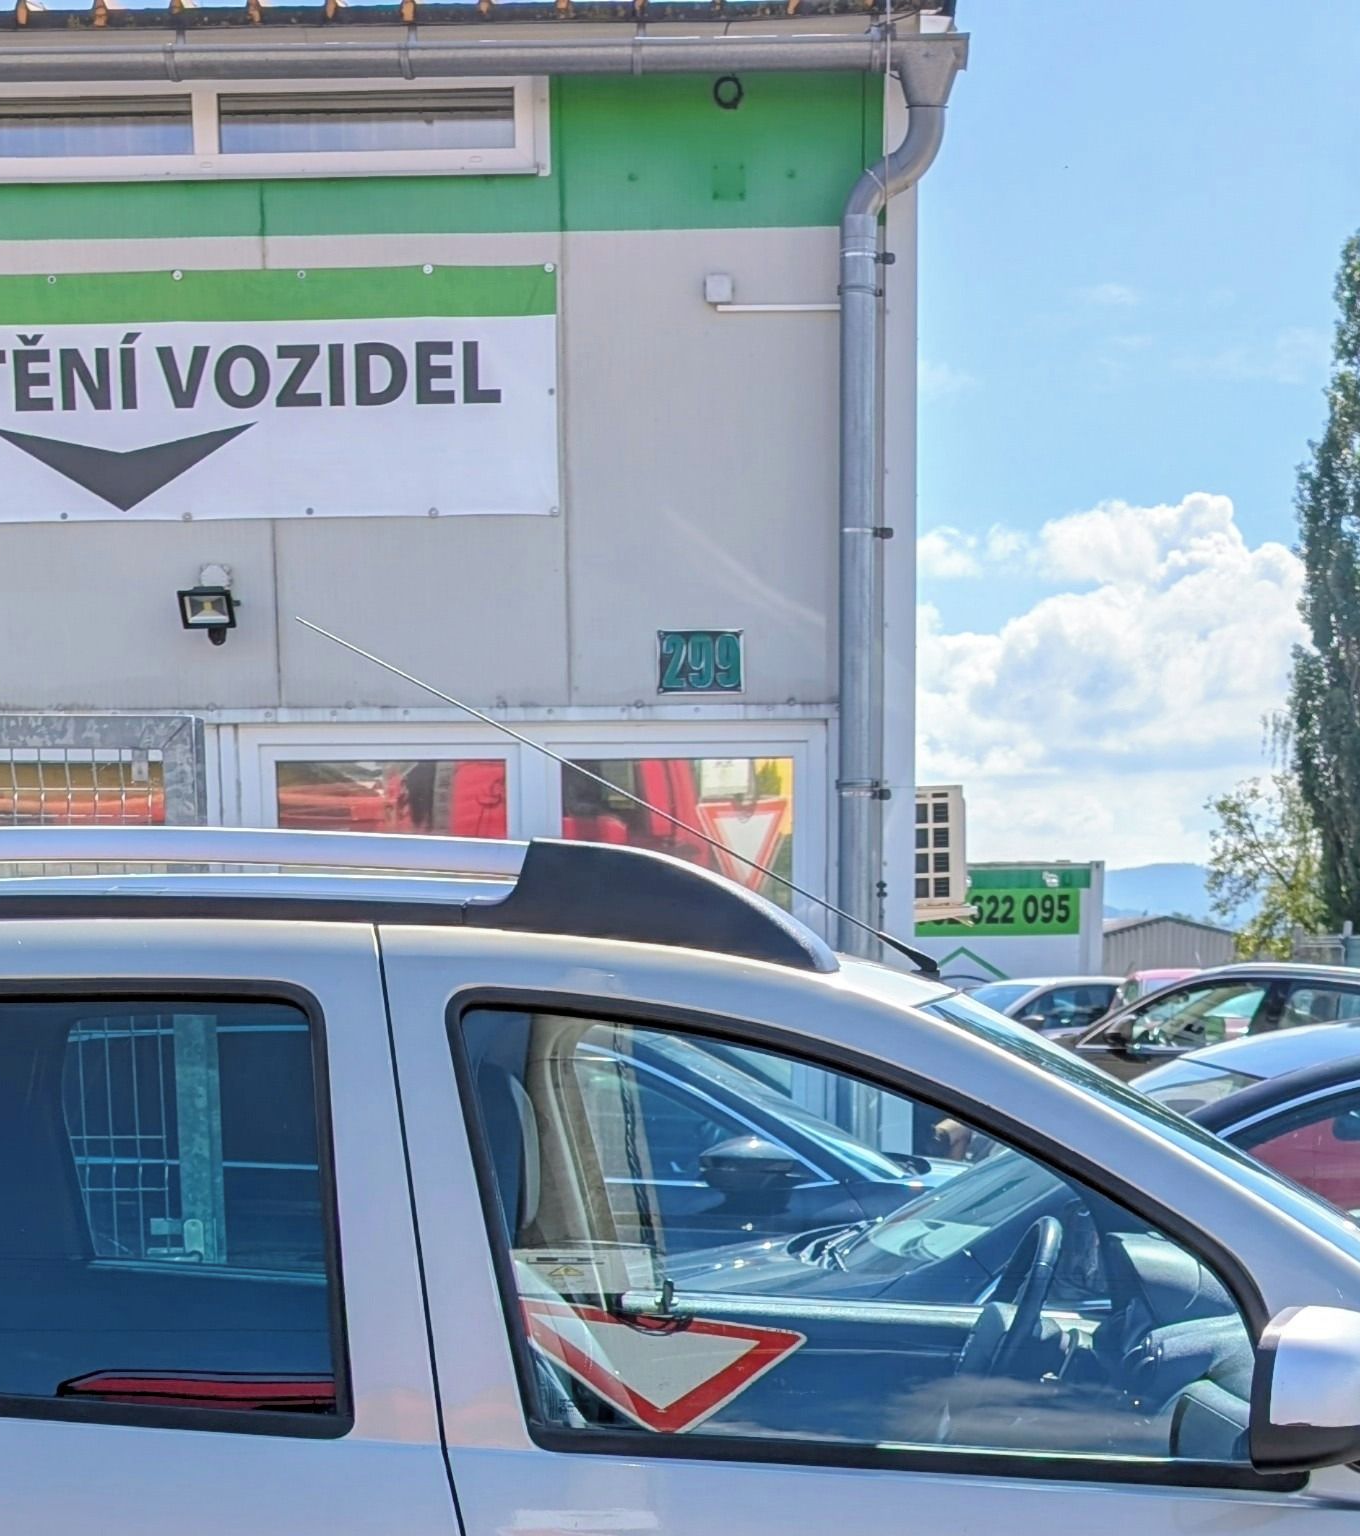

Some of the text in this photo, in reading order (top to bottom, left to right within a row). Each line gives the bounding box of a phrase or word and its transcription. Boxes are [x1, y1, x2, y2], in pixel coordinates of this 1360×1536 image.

[156, 340, 502, 409] VOZIDEL
[662, 633, 741, 688] 299
[1022, 893, 1071, 924] 095
